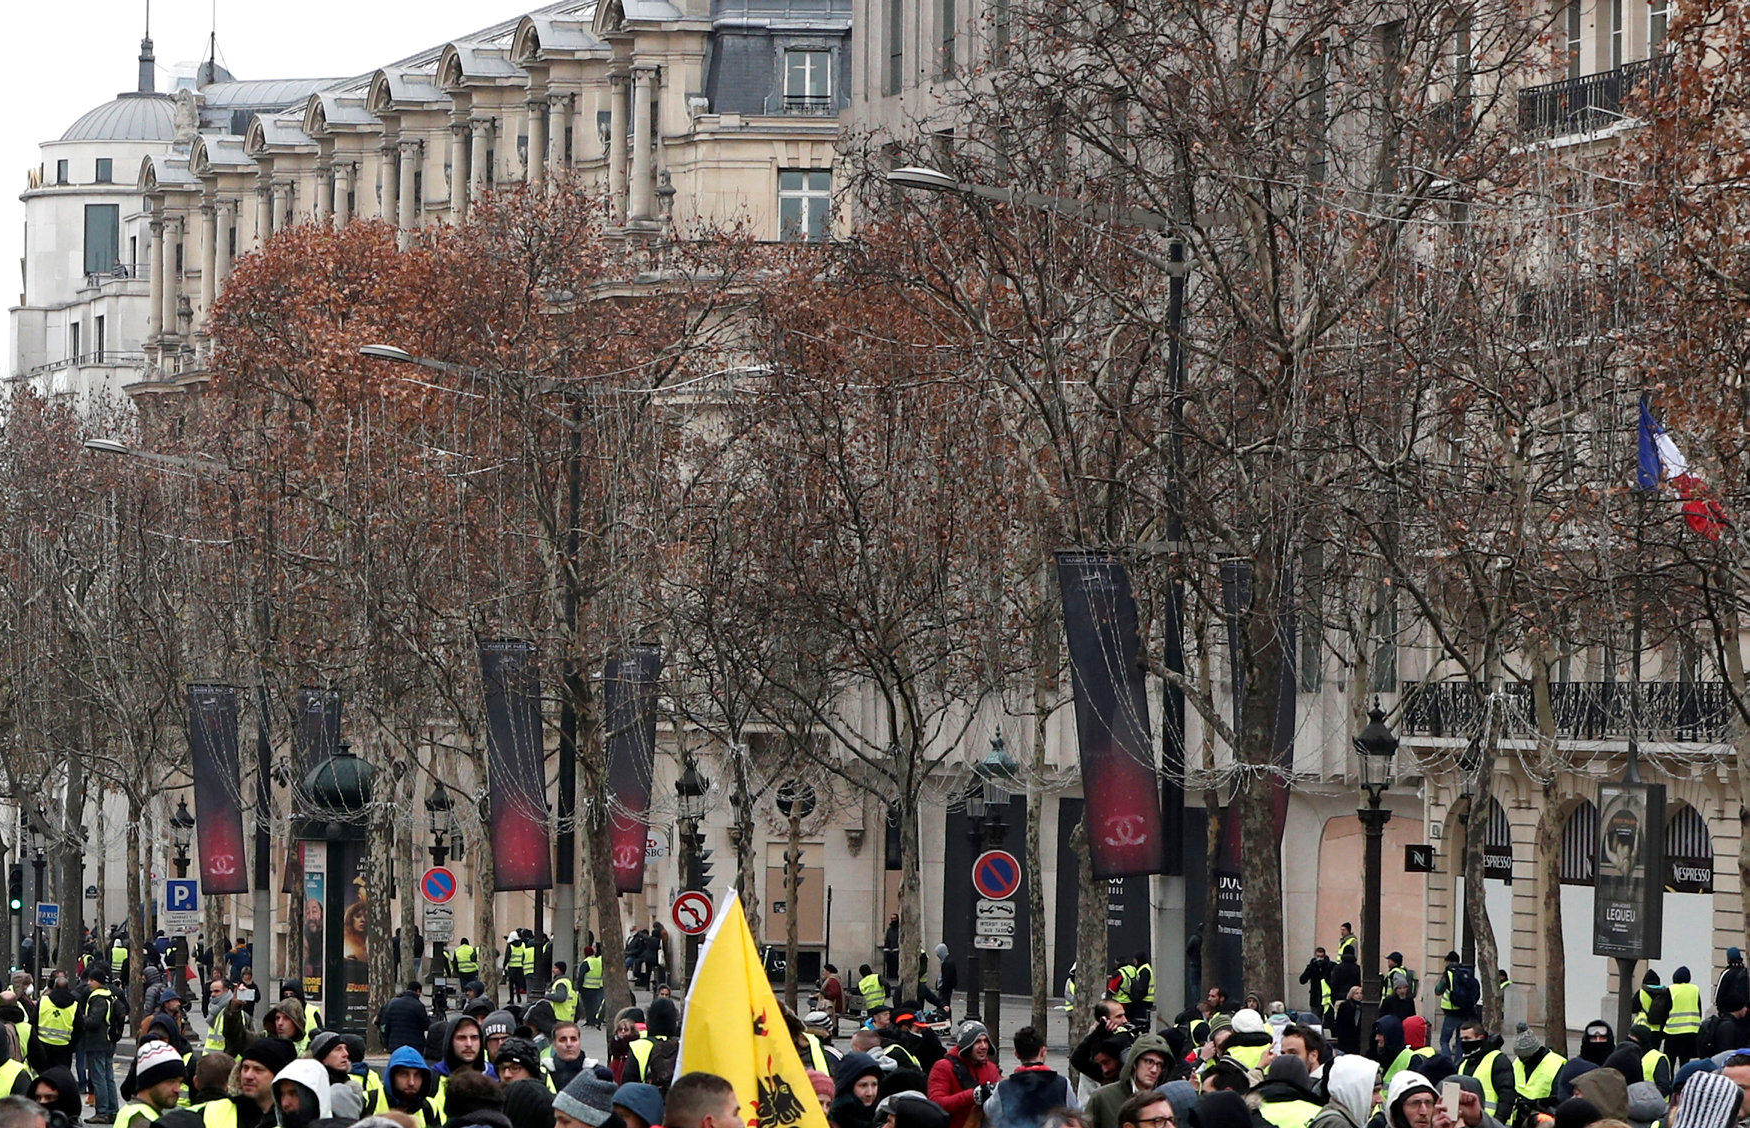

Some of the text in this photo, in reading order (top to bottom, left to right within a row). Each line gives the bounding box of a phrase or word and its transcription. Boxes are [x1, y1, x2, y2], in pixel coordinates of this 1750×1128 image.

[1672, 863, 1711, 883] NESPRESSO
[174, 885, 189, 907] P
[1606, 908, 1636, 922] LEQUEU
[485, 1024, 507, 1036] CRUSH
